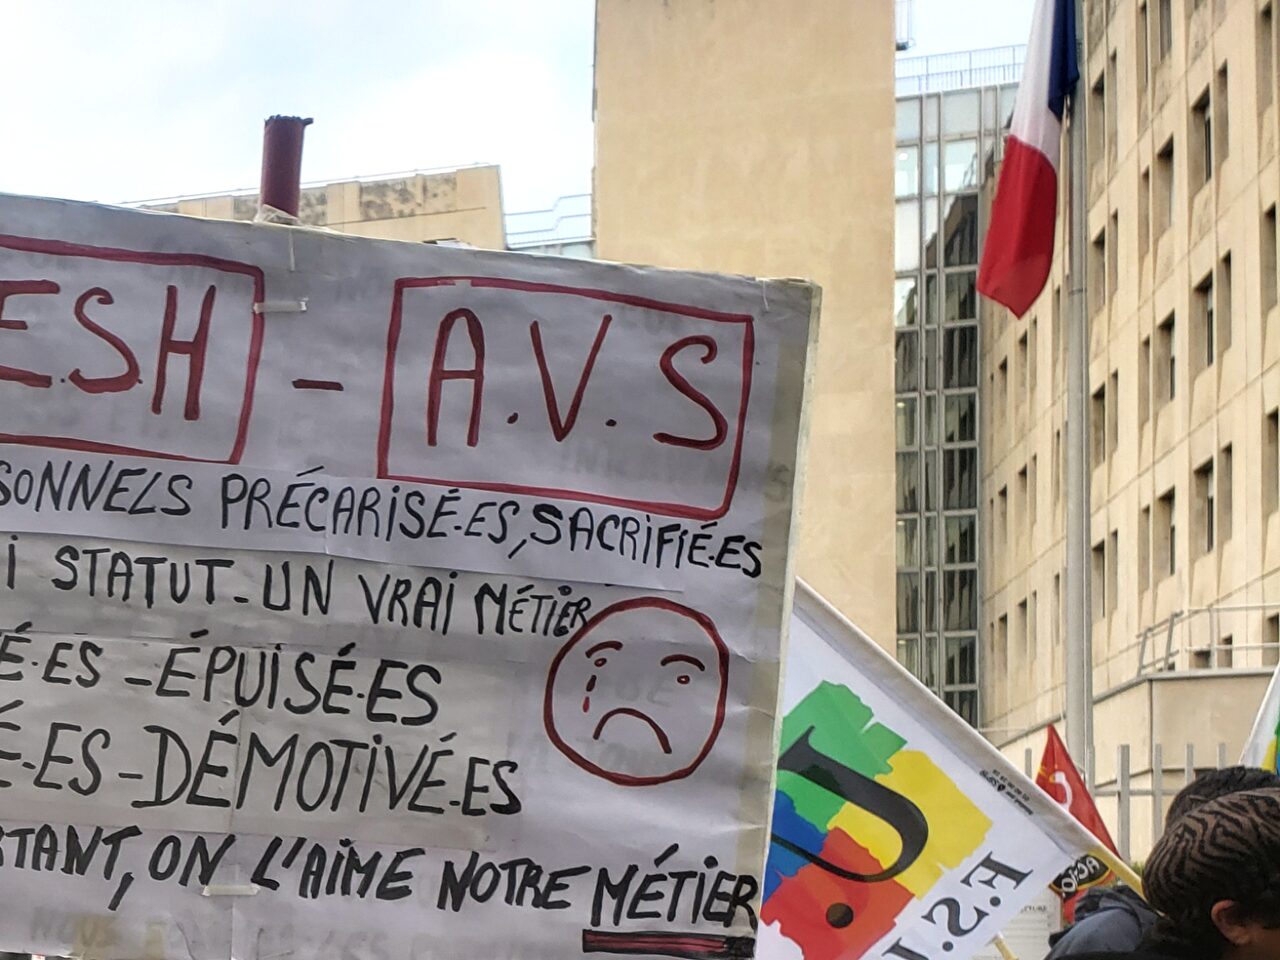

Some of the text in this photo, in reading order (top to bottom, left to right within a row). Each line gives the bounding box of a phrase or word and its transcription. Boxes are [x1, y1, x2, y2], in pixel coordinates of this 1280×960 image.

[427, 308, 729, 450] A.V.S
[357, 571, 459, 636] VRAI
[437, 852, 592, 913] NOTRE
[590, 843, 760, 929] MÉTIER
